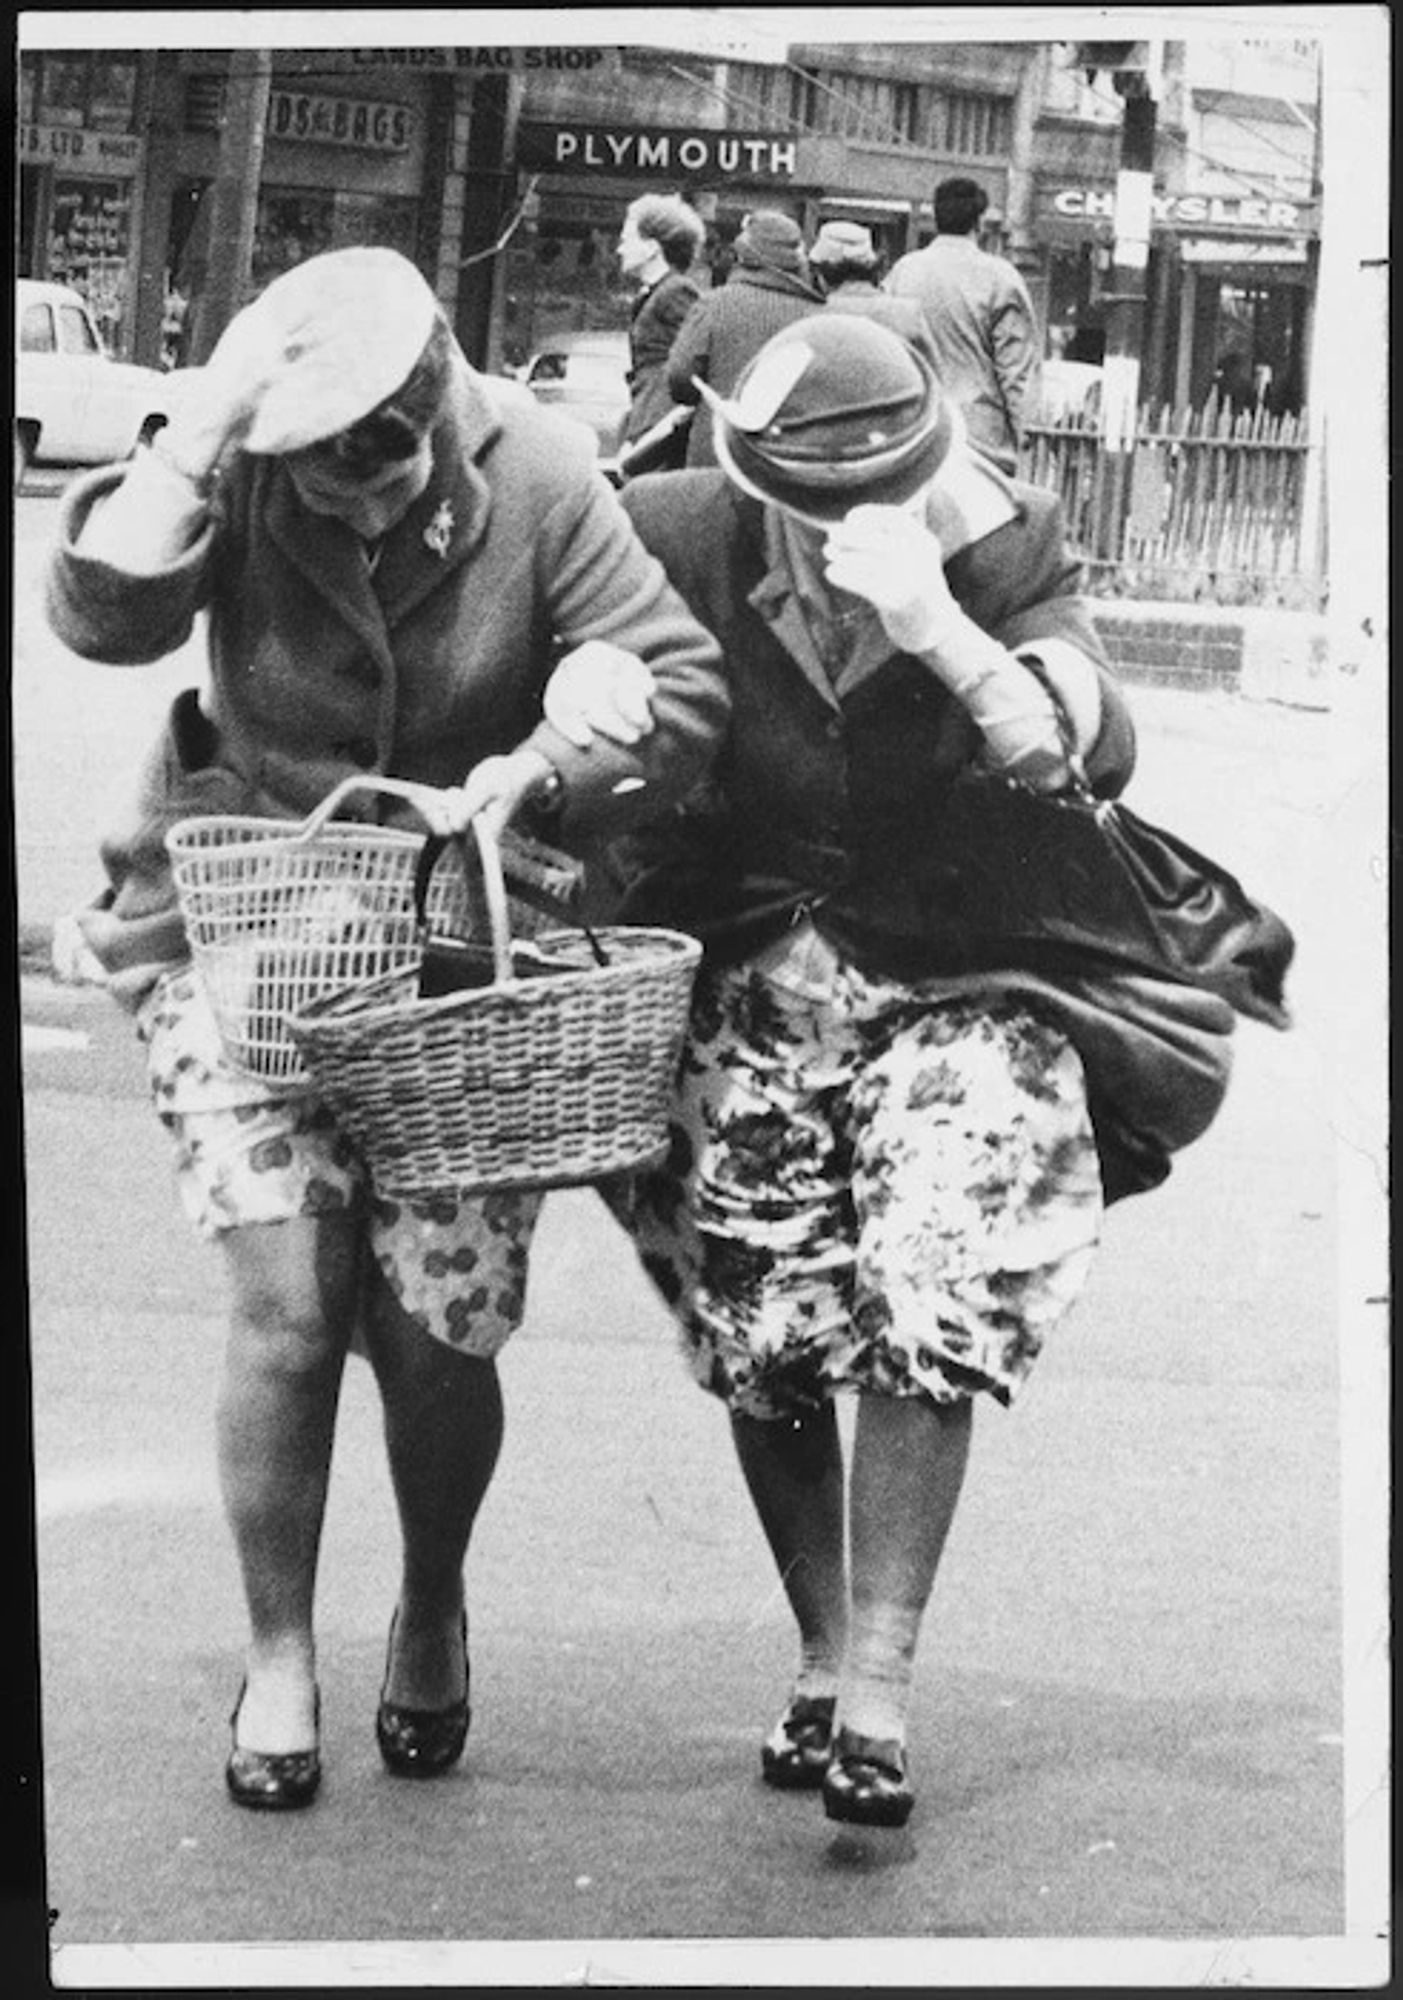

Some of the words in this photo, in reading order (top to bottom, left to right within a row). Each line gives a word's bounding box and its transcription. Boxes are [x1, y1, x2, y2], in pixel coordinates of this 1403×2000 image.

[454, 48, 514, 68] BAG
[524, 49, 603, 70] SHOP
[333, 102, 405, 146] BAGS
[556, 132, 796, 173] PLYMOUTH
[1054, 191, 1299, 227] CHYSLER
